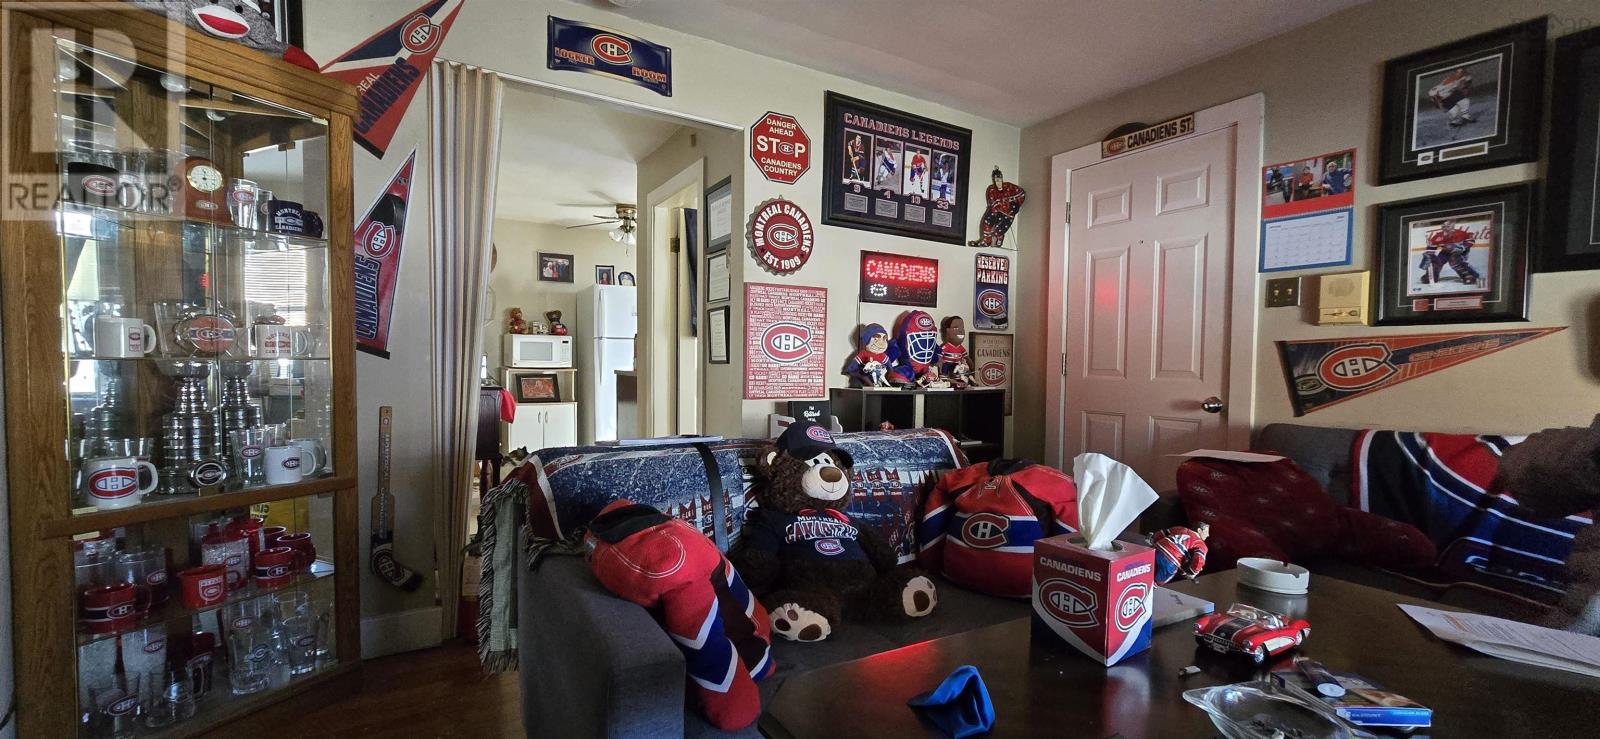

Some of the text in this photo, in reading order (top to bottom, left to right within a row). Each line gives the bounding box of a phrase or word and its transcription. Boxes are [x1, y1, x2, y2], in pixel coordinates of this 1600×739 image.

[554, 47, 595, 65] LOCKER
[631, 66, 667, 83] ROOM
[766, 118, 797, 130] DANGER
[769, 126, 794, 137] AHEAD
[843, 112, 960, 151] CANADIENS LEGENDS
[1127, 121, 1178, 148] CANADIENS
[760, 157, 802, 170] CANADIENS
[764, 165, 798, 177] COUNTRY
[936, 200, 949, 210] 33
[754, 204, 782, 247] MONTREAL
[784, 204, 812, 254] CANADIENS
[763, 251, 801, 270] EST. 1909
[977, 255, 1008, 271] RESERVED
[866, 259, 936, 283] CANADIENS
[976, 270, 1008, 284] PARKING
[976, 348, 1010, 358] CANADIENS
[1040, 556, 1102, 582] CANADIENS
[1116, 563, 1153, 583] CANADIENS
